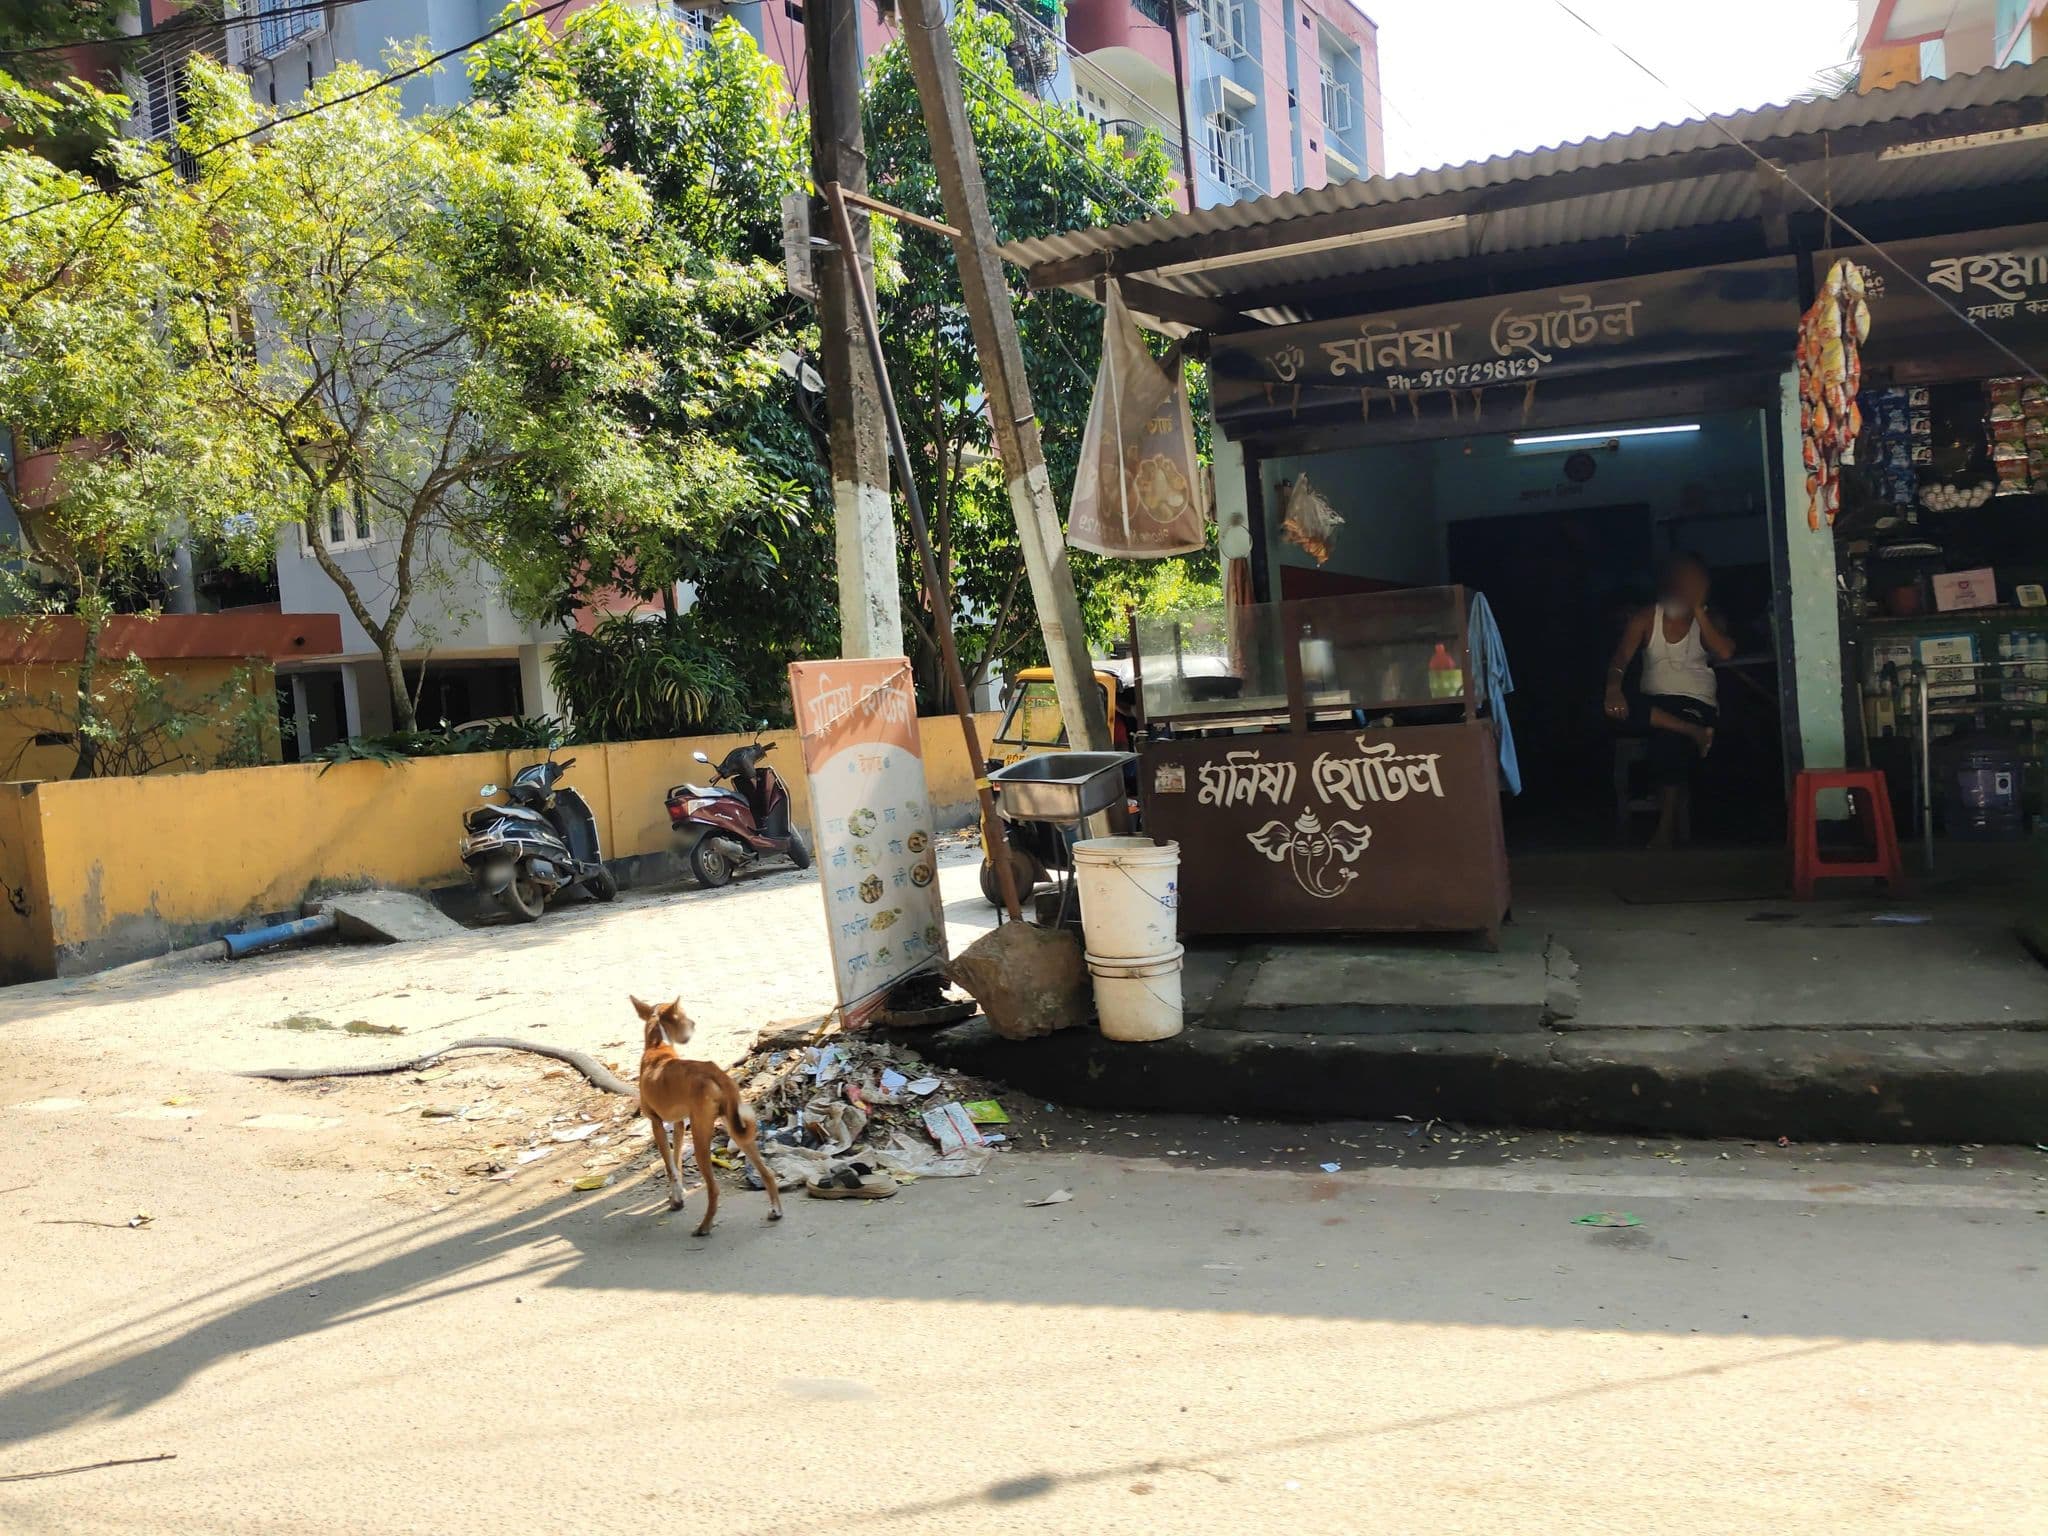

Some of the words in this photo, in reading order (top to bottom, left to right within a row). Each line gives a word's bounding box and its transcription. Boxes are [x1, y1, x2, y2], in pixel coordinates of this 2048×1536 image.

[1319, 319, 1461, 377] মনিষা
[1490, 294, 1643, 363] হোটেল
[1197, 750, 1298, 808] মনিষা
[1312, 734, 1446, 811] হোটেল
